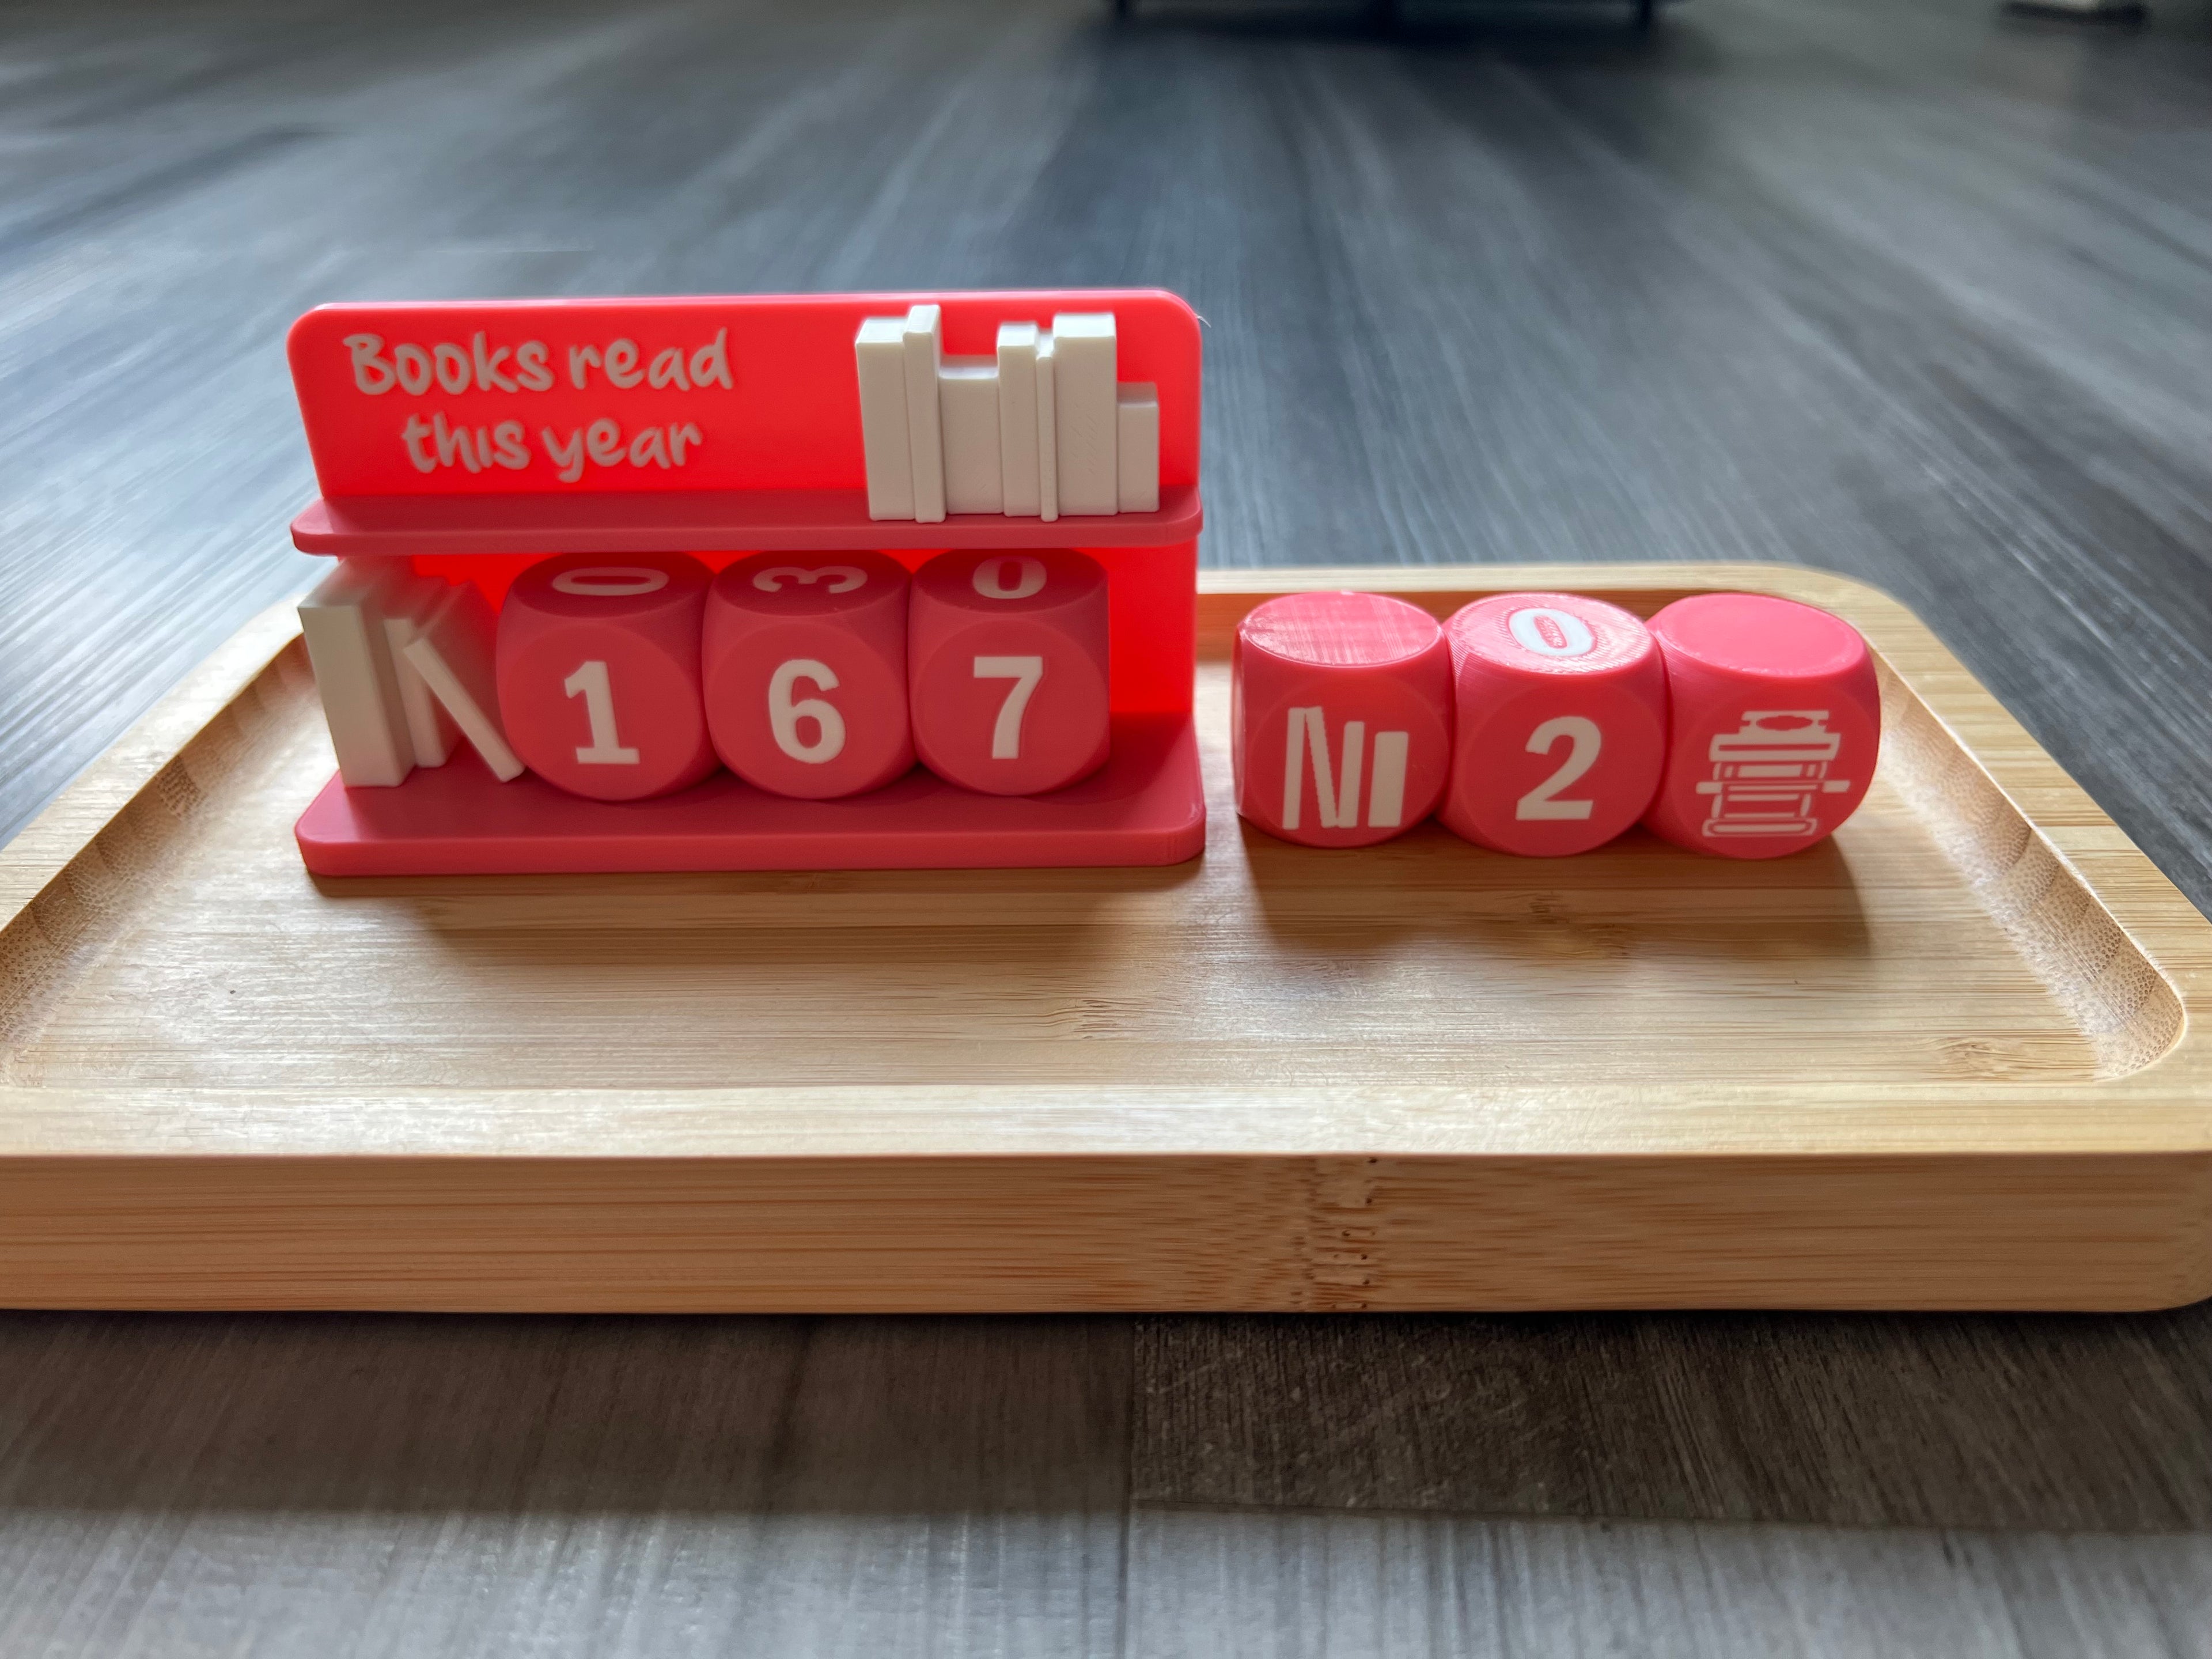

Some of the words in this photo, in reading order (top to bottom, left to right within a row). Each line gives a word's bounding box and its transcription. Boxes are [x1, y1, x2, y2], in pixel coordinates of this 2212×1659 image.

[343, 331, 554, 396] Books
[567, 327, 733, 391] read
[402, 411, 532, 474] this
[541, 417, 703, 483] year
[1508, 607, 1593, 657] 0
[564, 661, 640, 765] 1
[767, 658, 847, 764] 6
[973, 656, 1043, 759] 7
[1516, 716, 1602, 821] 2
